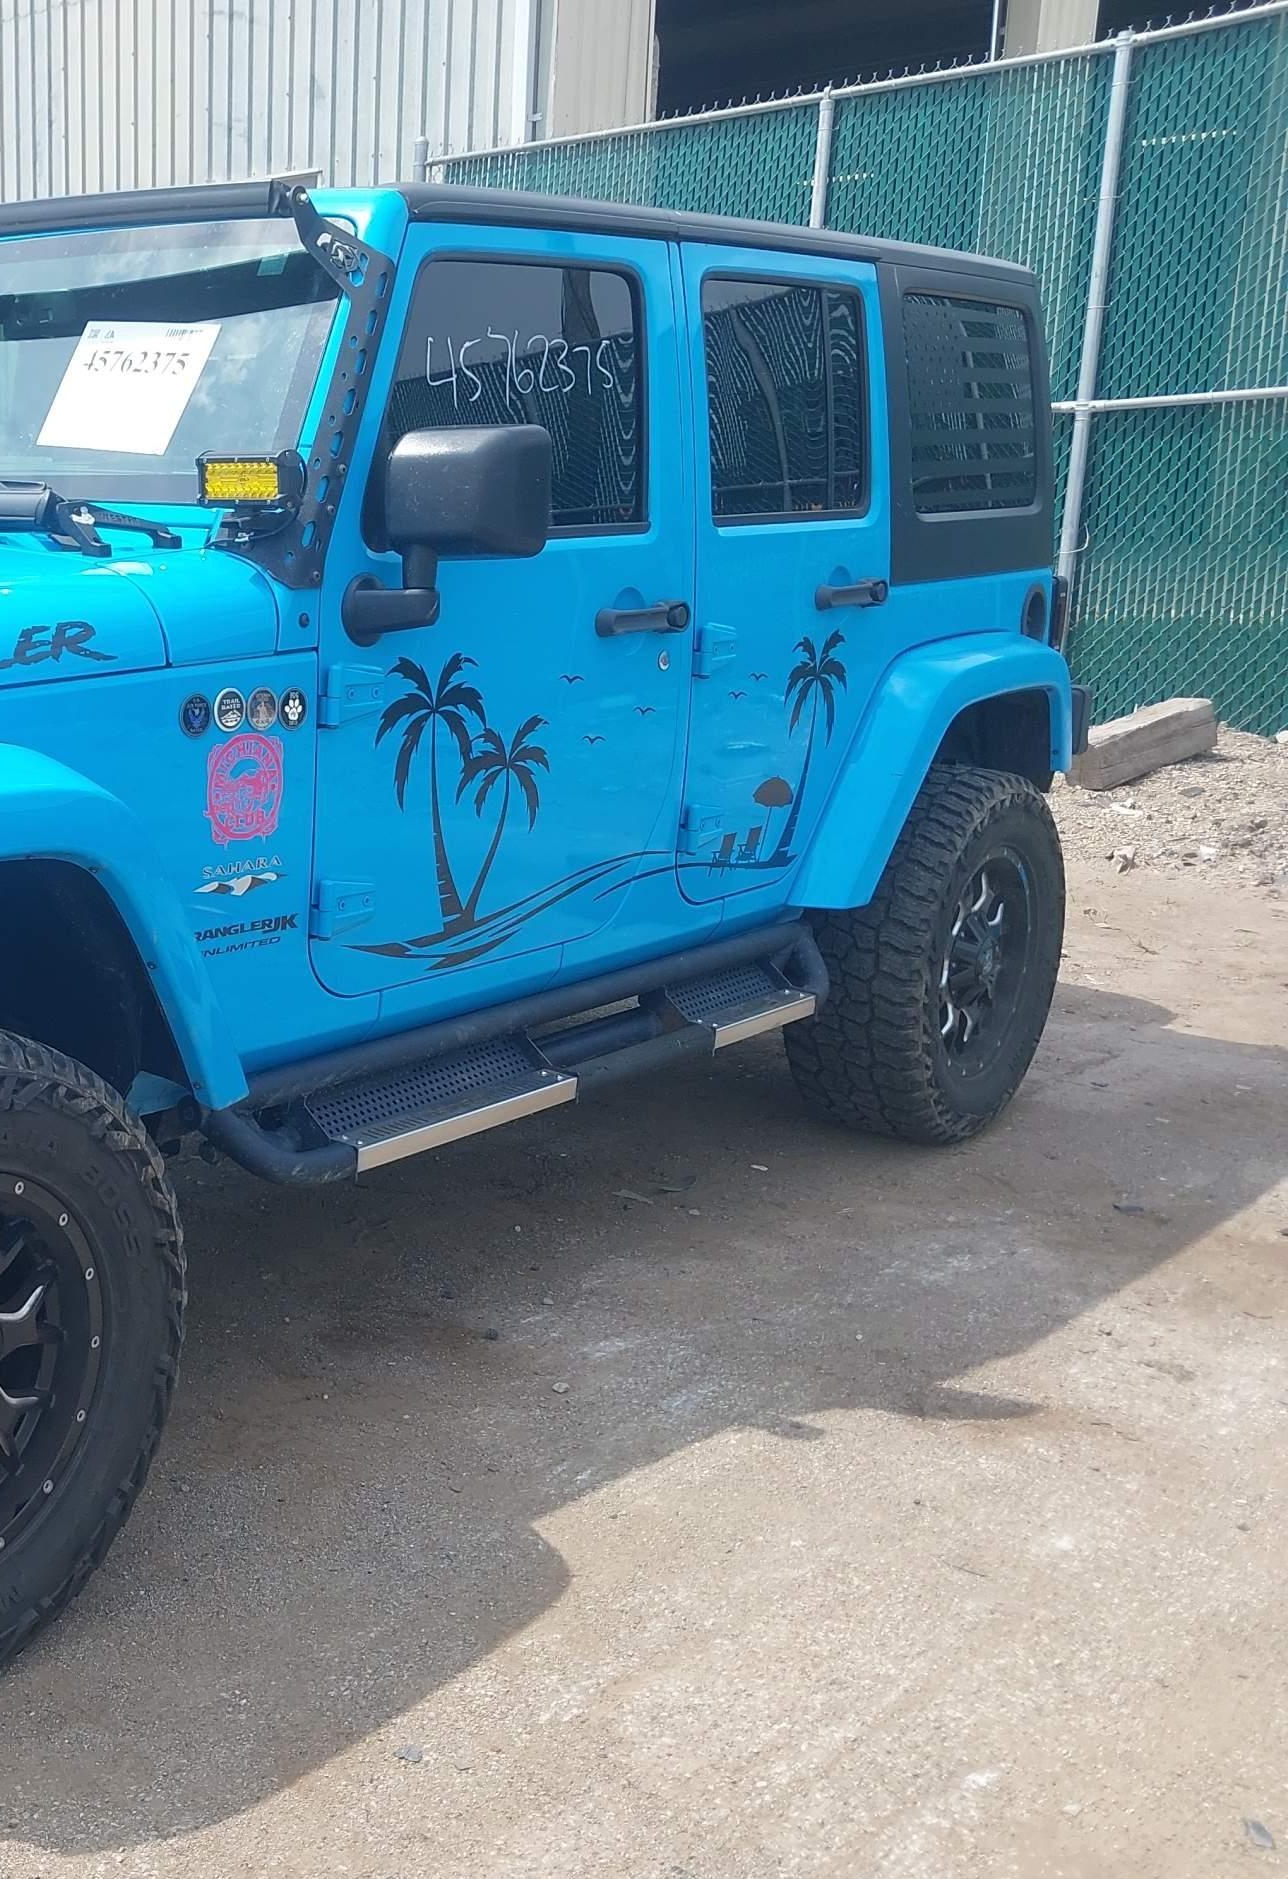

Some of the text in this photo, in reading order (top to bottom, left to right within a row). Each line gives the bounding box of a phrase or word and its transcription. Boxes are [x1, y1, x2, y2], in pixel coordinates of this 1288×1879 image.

[82, 349, 192, 376] 45762375
[425, 326, 614, 410] 45762375
[221, 703, 242, 711] RATED
[222, 698, 241, 706] TRAIL
[202, 855, 282, 879] SAHARA
